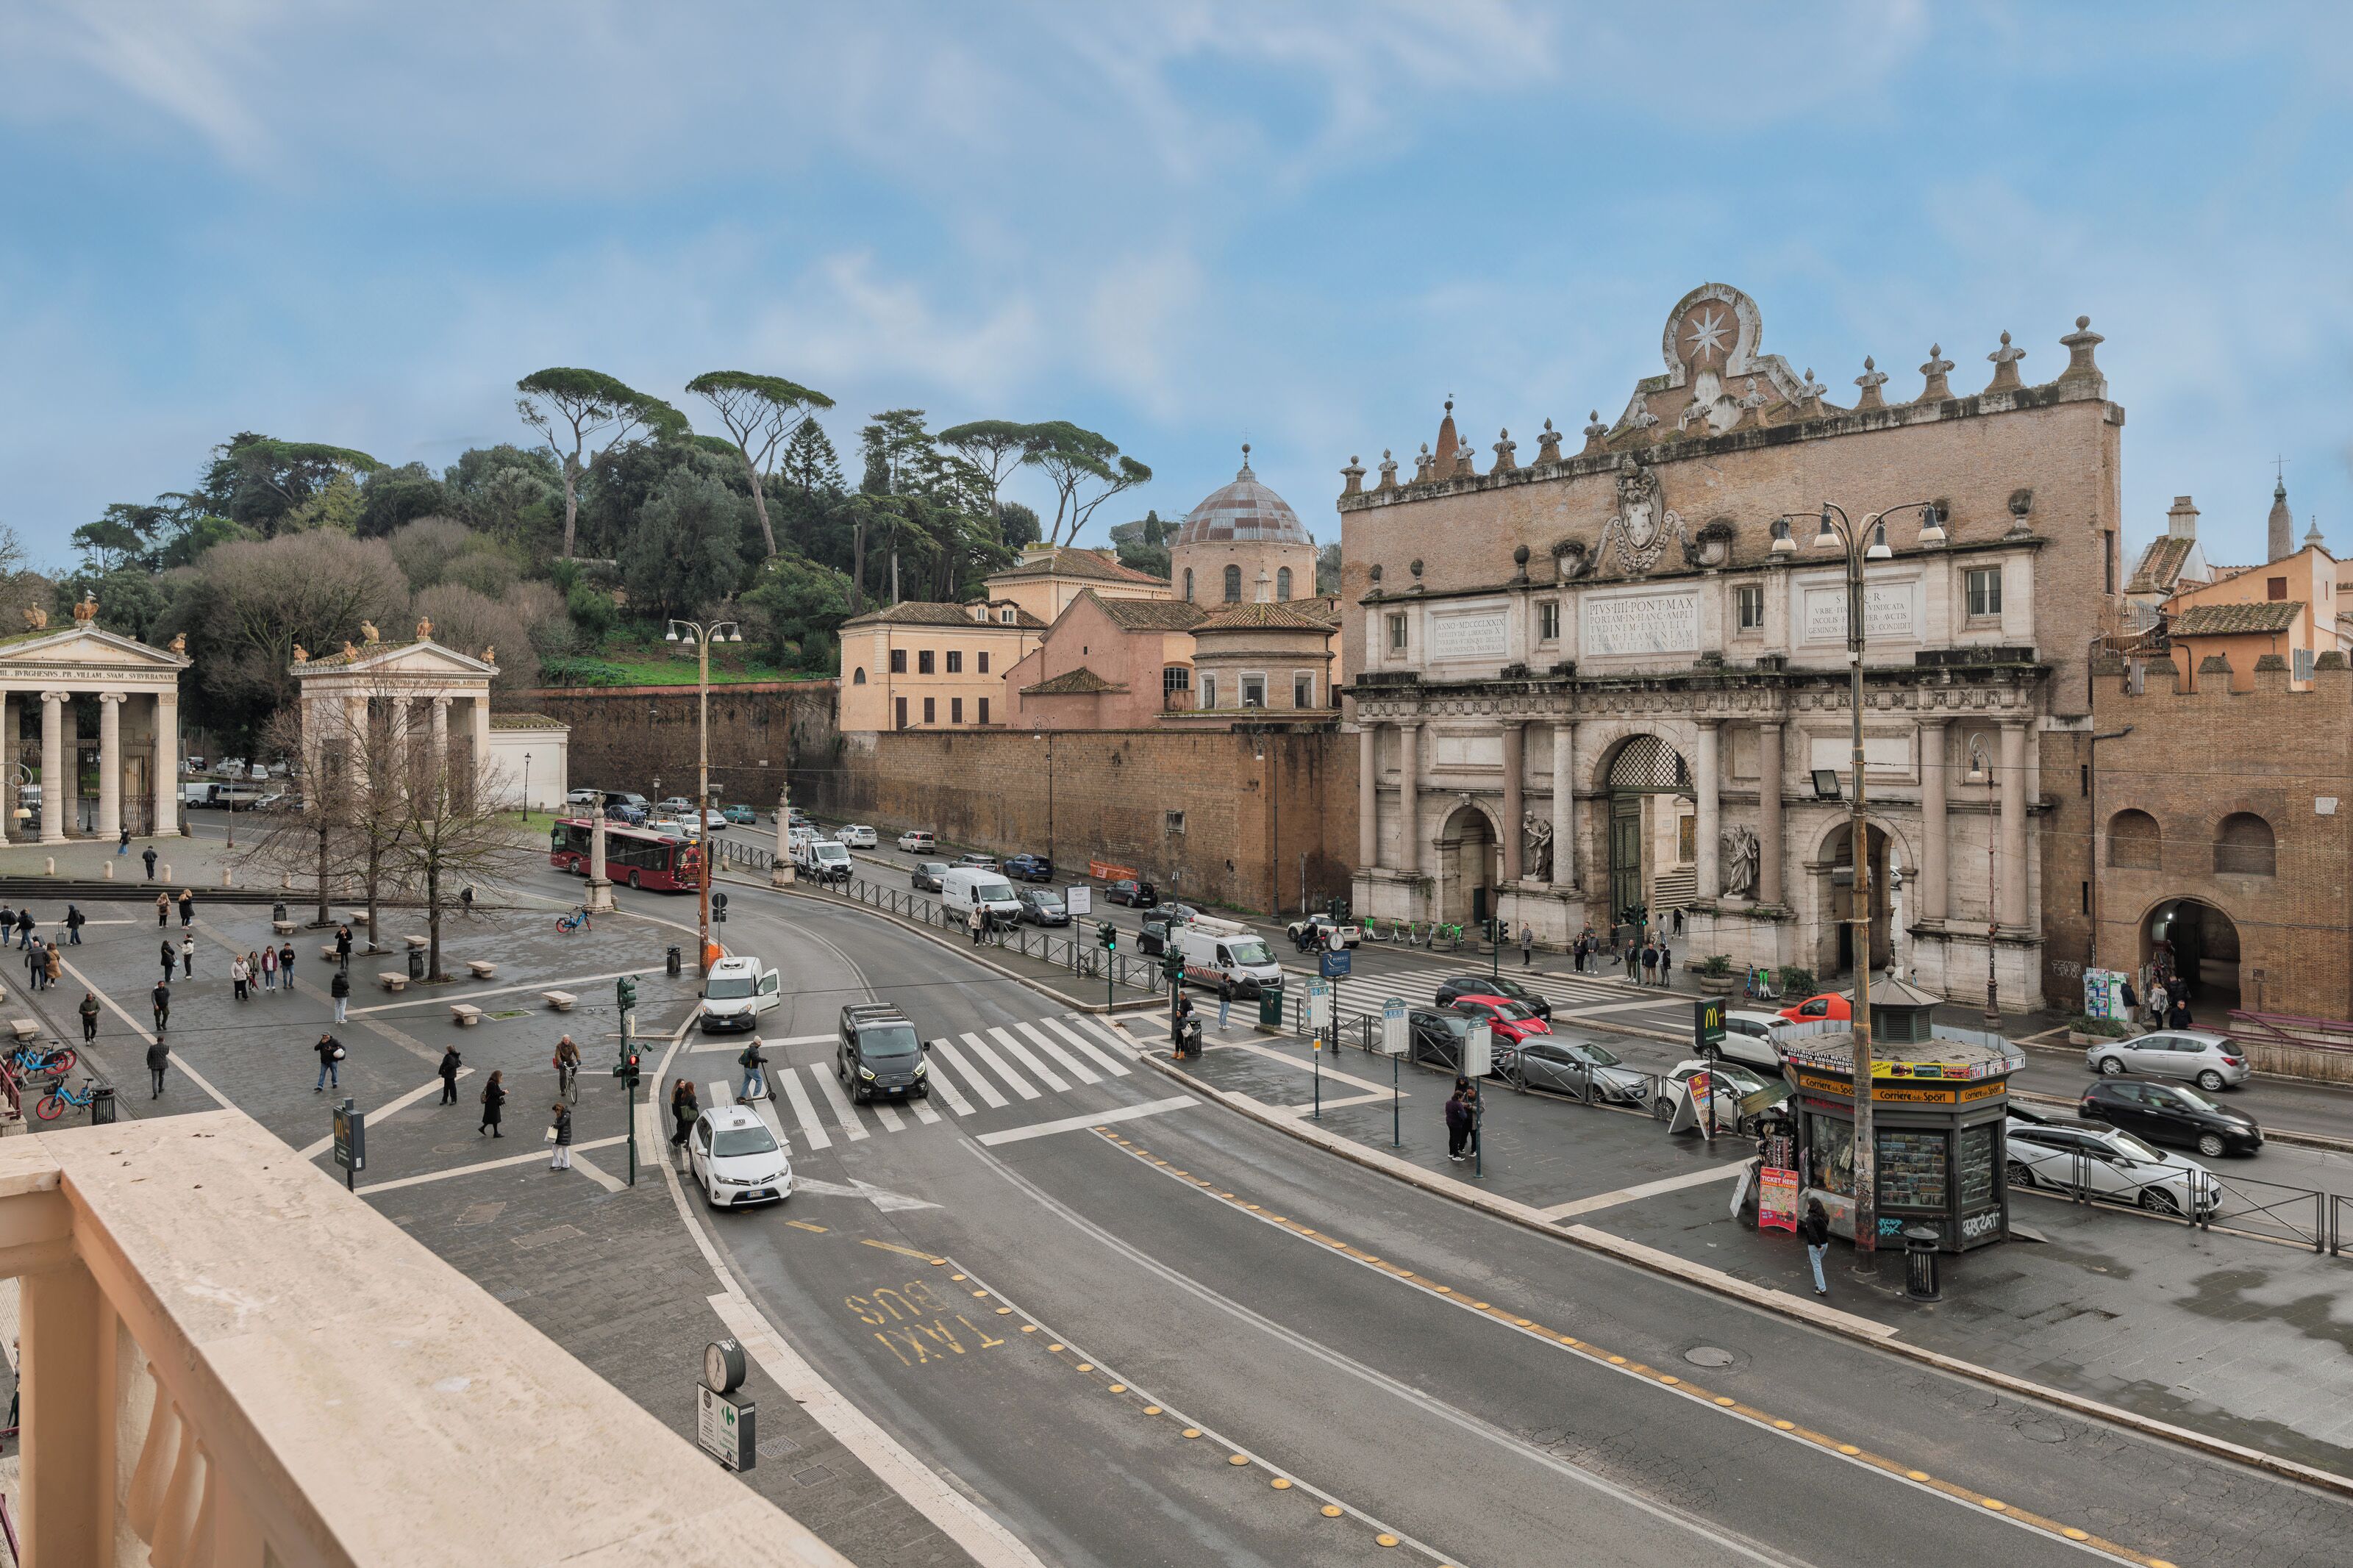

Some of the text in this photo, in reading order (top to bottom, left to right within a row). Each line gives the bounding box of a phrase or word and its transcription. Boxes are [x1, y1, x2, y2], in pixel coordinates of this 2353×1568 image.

[1437, 622, 1455, 631] ANNO
[1806, 1078, 1831, 1091] Corriere
[1880, 1090, 1912, 1100] Corriere
[1965, 1090, 1983, 1100] Corriere
[1761, 1175, 1782, 1184] TICKET
[843, 1280, 951, 1325] BUS
[874, 1314, 1005, 1367] TAXI
